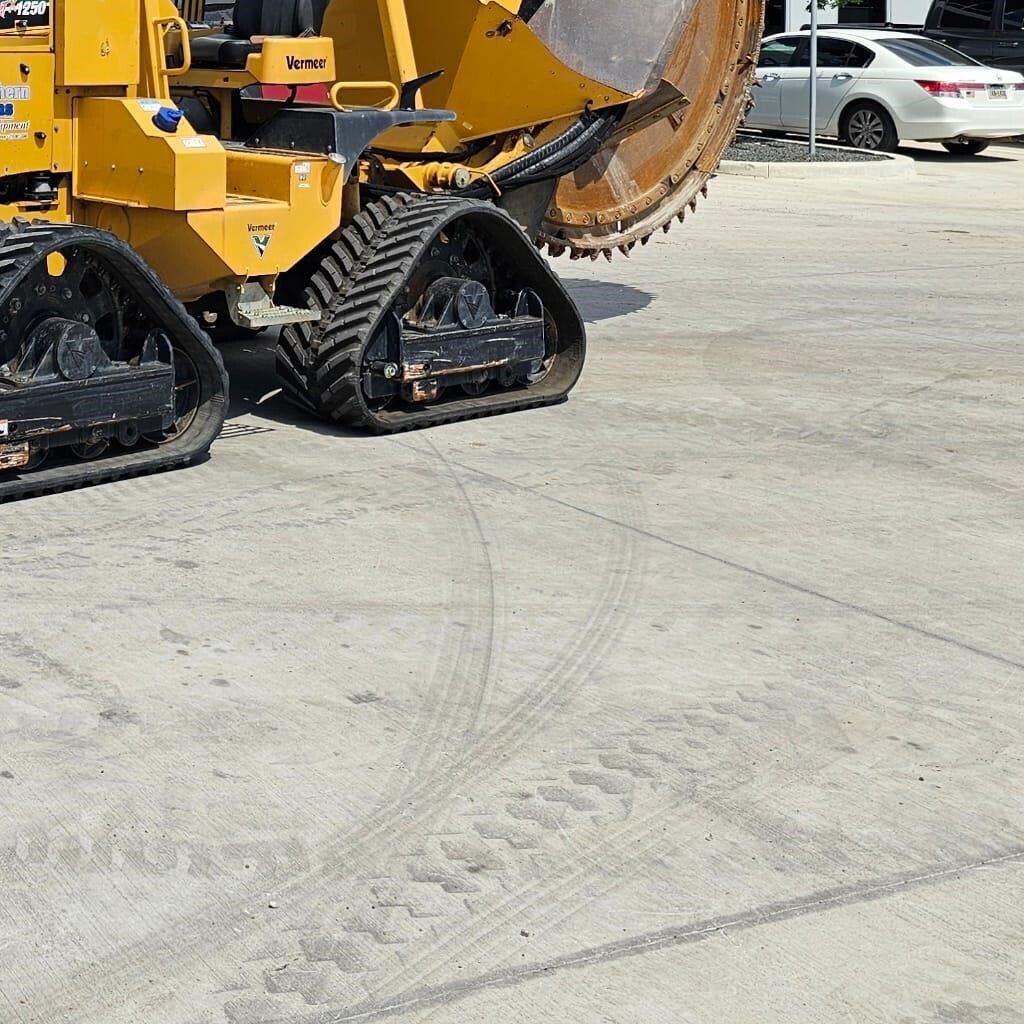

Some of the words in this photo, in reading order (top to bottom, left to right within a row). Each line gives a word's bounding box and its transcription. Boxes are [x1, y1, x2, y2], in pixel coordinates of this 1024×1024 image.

[16, 0, 47, 16] 1250
[286, 55, 327, 70] Vermeer
[247, 223, 275, 232] Vermeer
